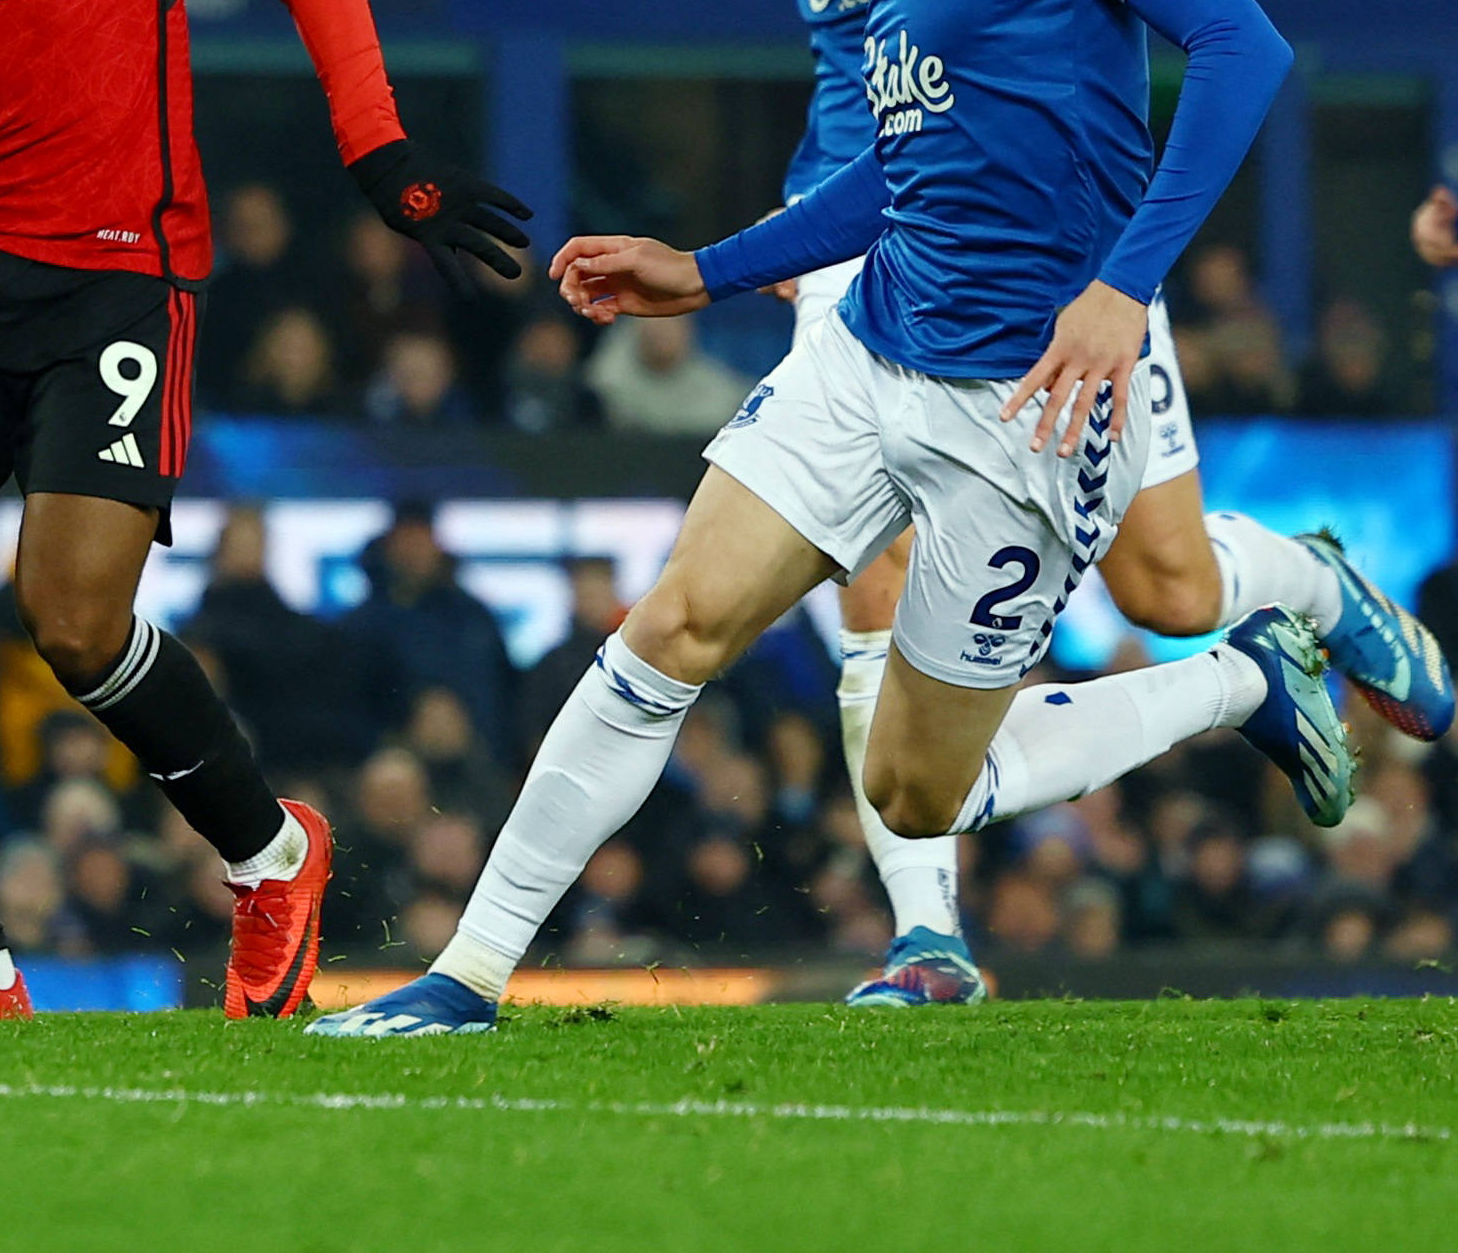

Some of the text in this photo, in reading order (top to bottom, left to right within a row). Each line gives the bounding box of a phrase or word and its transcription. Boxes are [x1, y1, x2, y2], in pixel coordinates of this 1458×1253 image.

[879, 108, 923, 138] .com
[99, 341, 158, 428] 9
[969, 545, 1041, 631] 2
